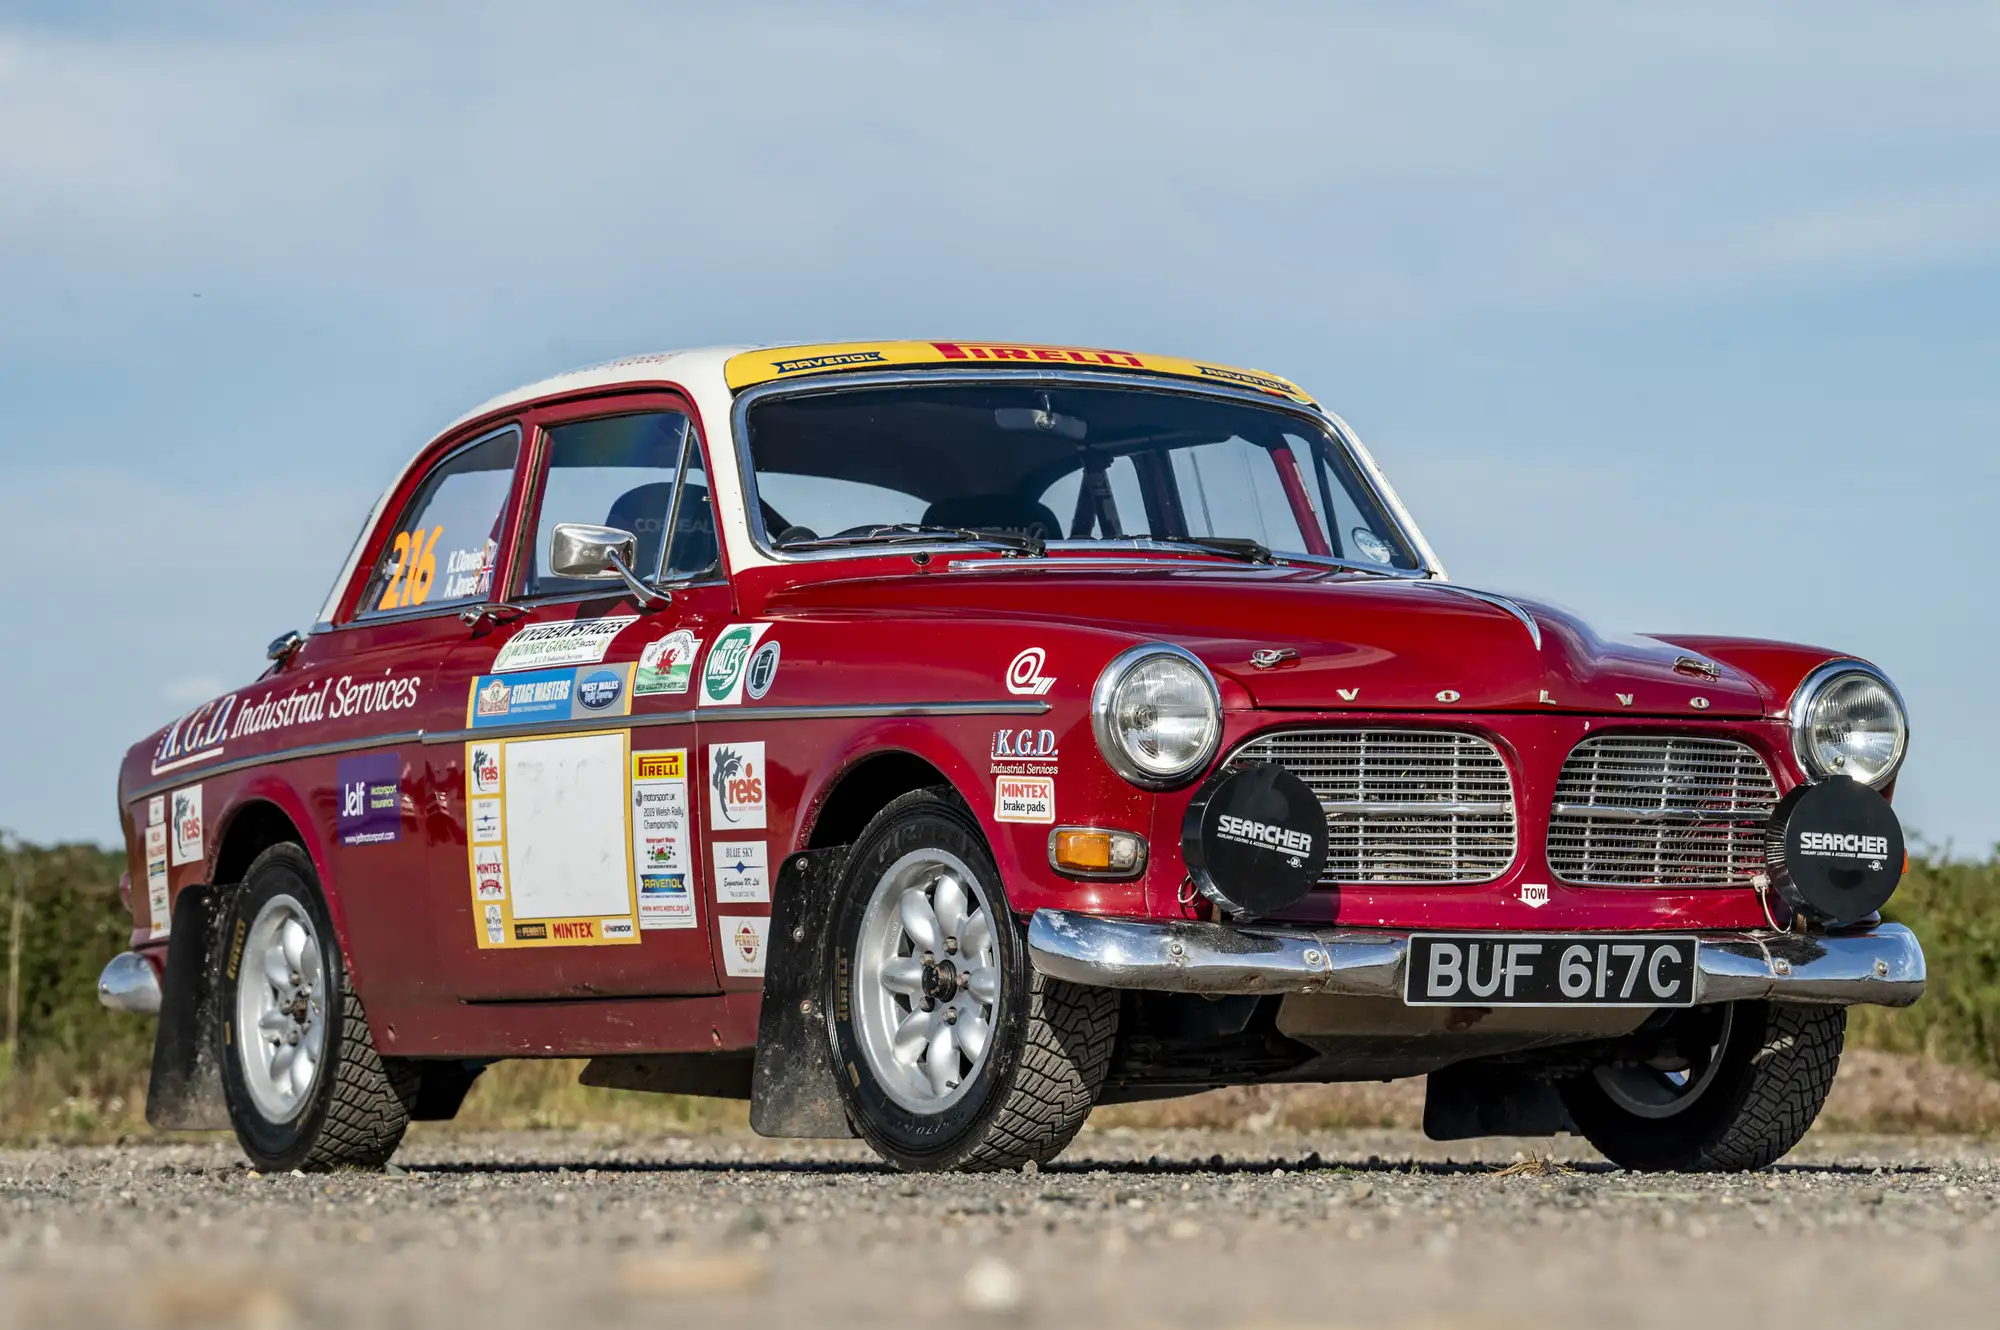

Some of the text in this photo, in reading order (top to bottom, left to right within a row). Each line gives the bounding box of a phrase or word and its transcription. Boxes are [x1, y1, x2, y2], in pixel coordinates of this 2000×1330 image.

[782, 354, 878, 370] RAVENOL
[928, 342, 1144, 367] PIRELLI
[1203, 369, 1289, 391] RAVENOL
[378, 524, 444, 610] 216
[511, 620, 631, 643] WYEDEAN STAGES
[510, 645, 547, 656] WINNER
[546, 639, 581, 653] GARAGE
[511, 683, 536, 704] STAGE
[534, 680, 571, 702] MASTERS
[582, 681, 619, 692] WEST WALES
[231, 677, 333, 738] Industrial
[329, 668, 421, 718] Services
[1336, 687, 1710, 710] VOLVO
[997, 729, 1059, 756] K.G.D.
[481, 757, 498, 780] reis
[639, 756, 678, 776] PIRELLI
[990, 763, 1058, 775] Industrial Services
[729, 762, 762, 804] reis
[1001, 784, 1048, 798] MINTEX
[343, 781, 365, 817] Jelf
[643, 793, 669, 801] motorsport
[1004, 800, 1046, 814] brake pads
[644, 806, 684, 817] 2019 Welsh Rally
[182, 804, 200, 841] reis
[644, 820, 678, 830] Championship
[1218, 814, 1312, 851] SEARCHER
[726, 847, 753, 858] BLUE SKY
[1800, 832, 1888, 853] SEARCHER
[476, 863, 502, 874] MINTEX
[644, 879, 682, 888] RAVENOL
[1523, 888, 1546, 899] TOW
[552, 922, 593, 939] MINTEX
[1427, 943, 1682, 998] BUF 617C
